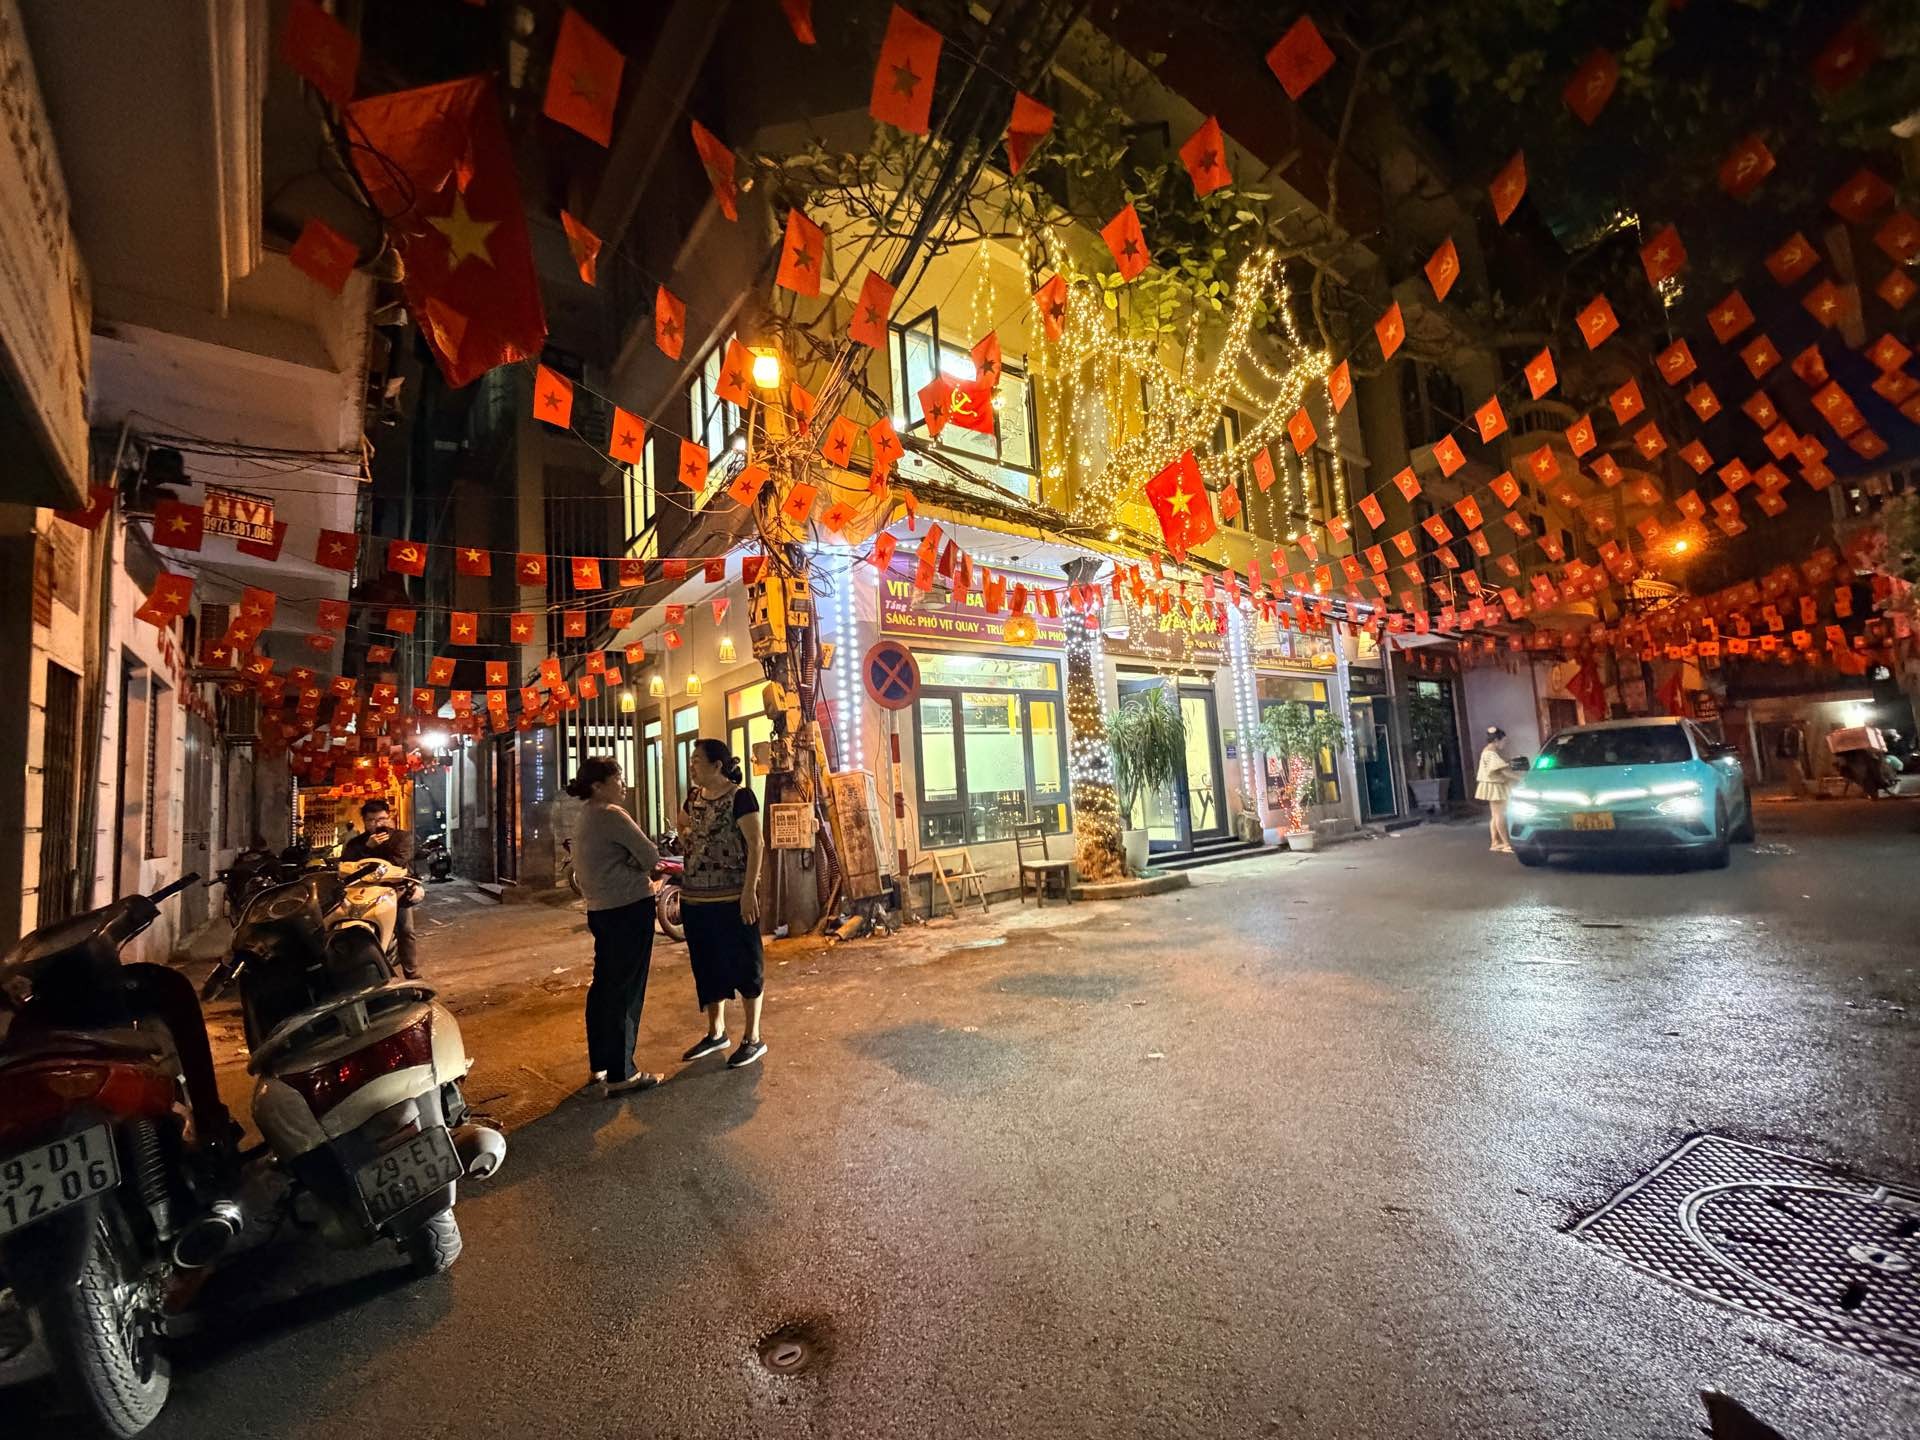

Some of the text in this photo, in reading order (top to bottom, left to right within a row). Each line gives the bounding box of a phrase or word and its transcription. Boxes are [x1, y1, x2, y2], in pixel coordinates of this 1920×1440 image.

[955, 620, 979, 634] QUAY
[0, 1134, 89, 1200] 9-D1
[375, 1135, 438, 1187] 29-E1
